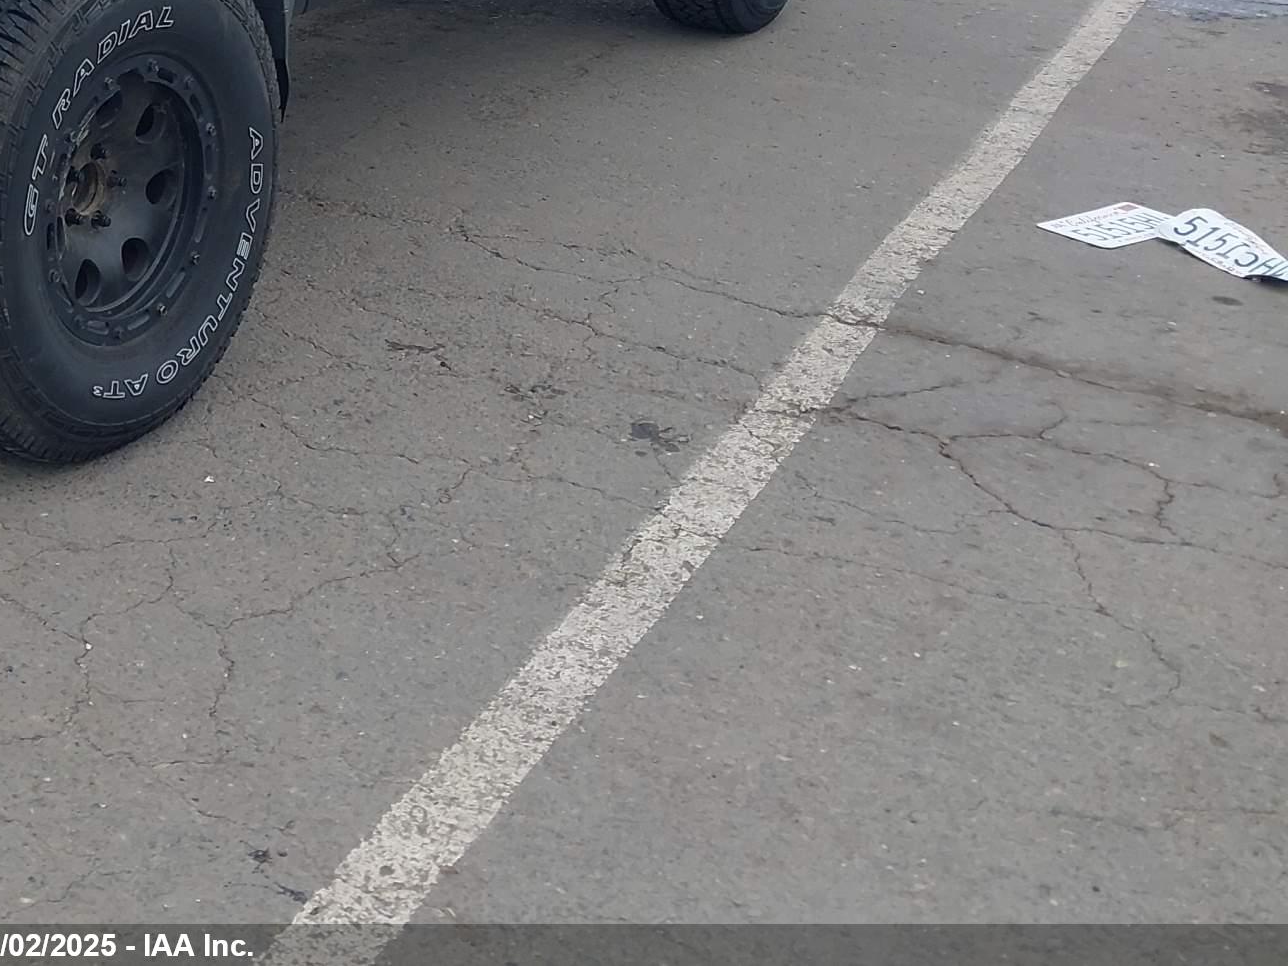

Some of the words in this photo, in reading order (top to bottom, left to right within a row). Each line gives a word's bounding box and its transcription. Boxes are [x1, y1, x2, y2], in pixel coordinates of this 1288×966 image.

[21, 132, 49, 237] GT
[51, 5, 176, 129] RADIAL
[154, 126, 265, 386] ADVENTURO
